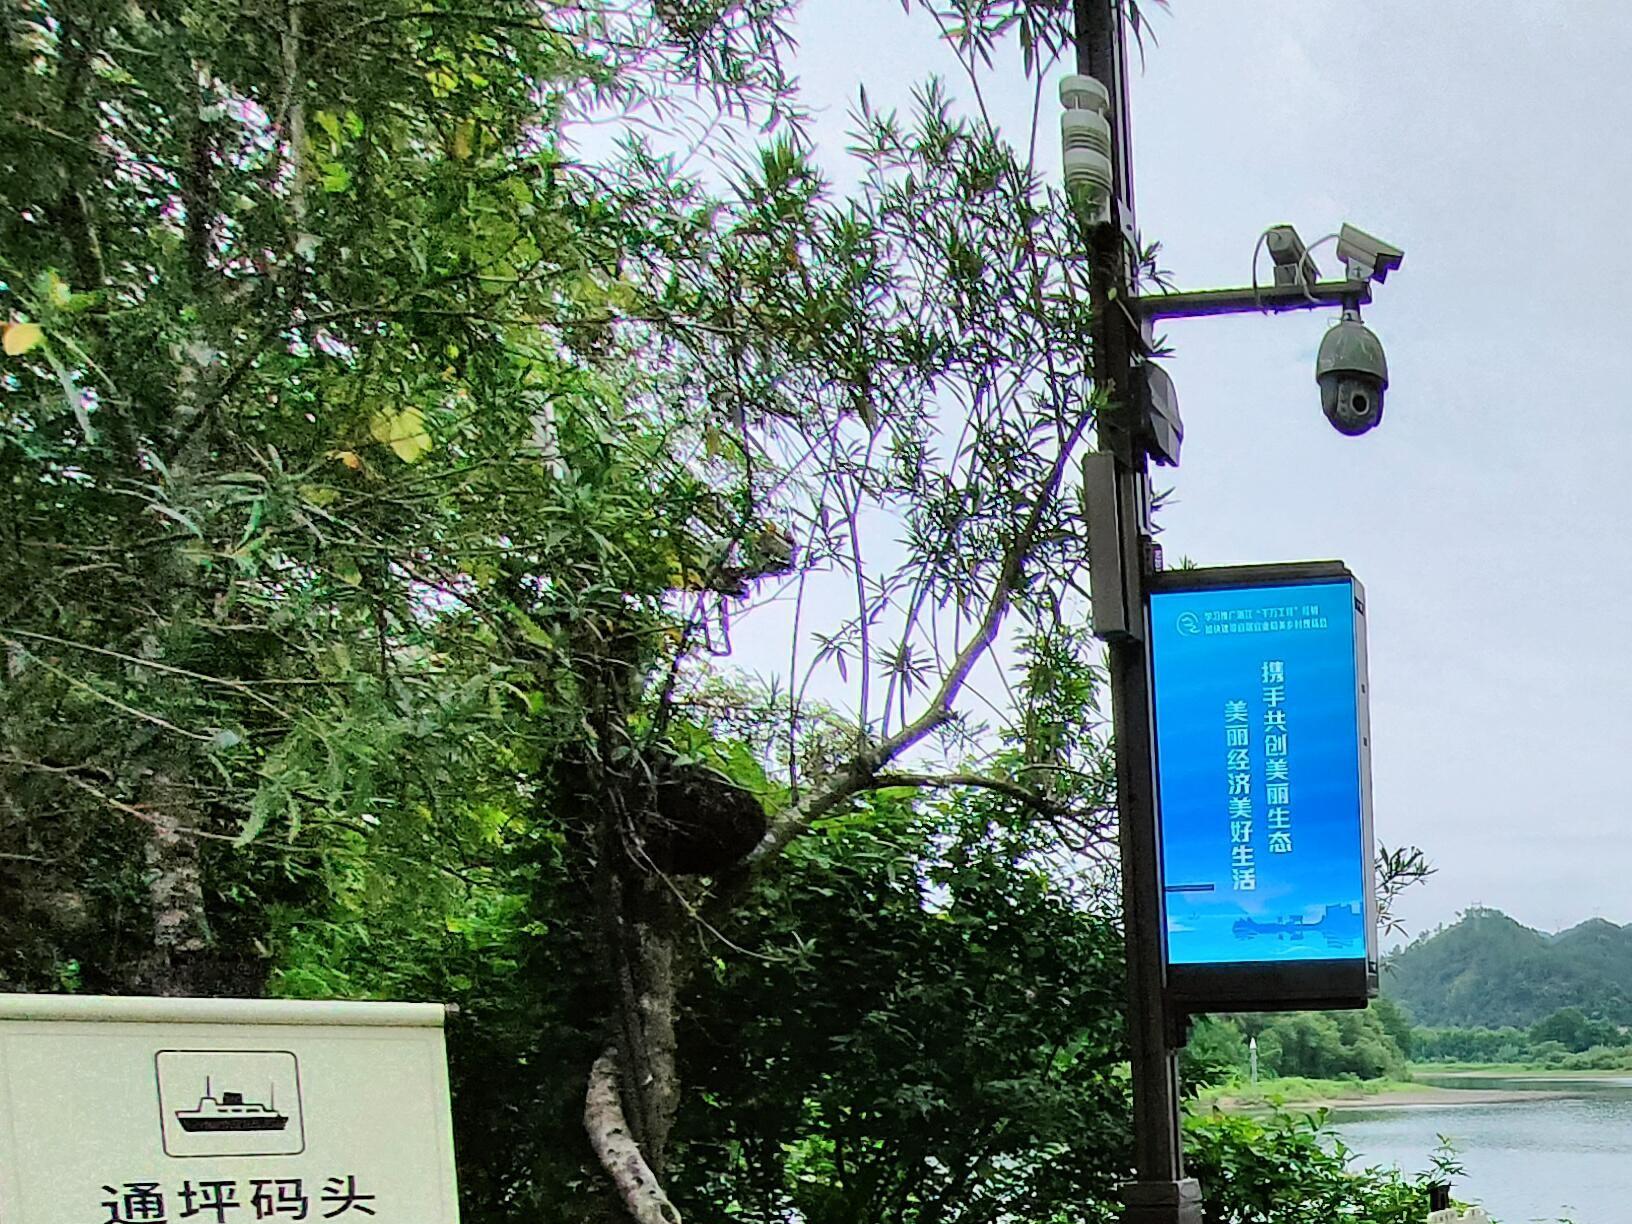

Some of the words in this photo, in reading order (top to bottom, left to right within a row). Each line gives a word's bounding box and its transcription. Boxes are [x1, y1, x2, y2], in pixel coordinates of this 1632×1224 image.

[1224, 700, 1257, 892] 美丽经济美好生活
[1261, 660, 1293, 854] 携手共创美丽生态
